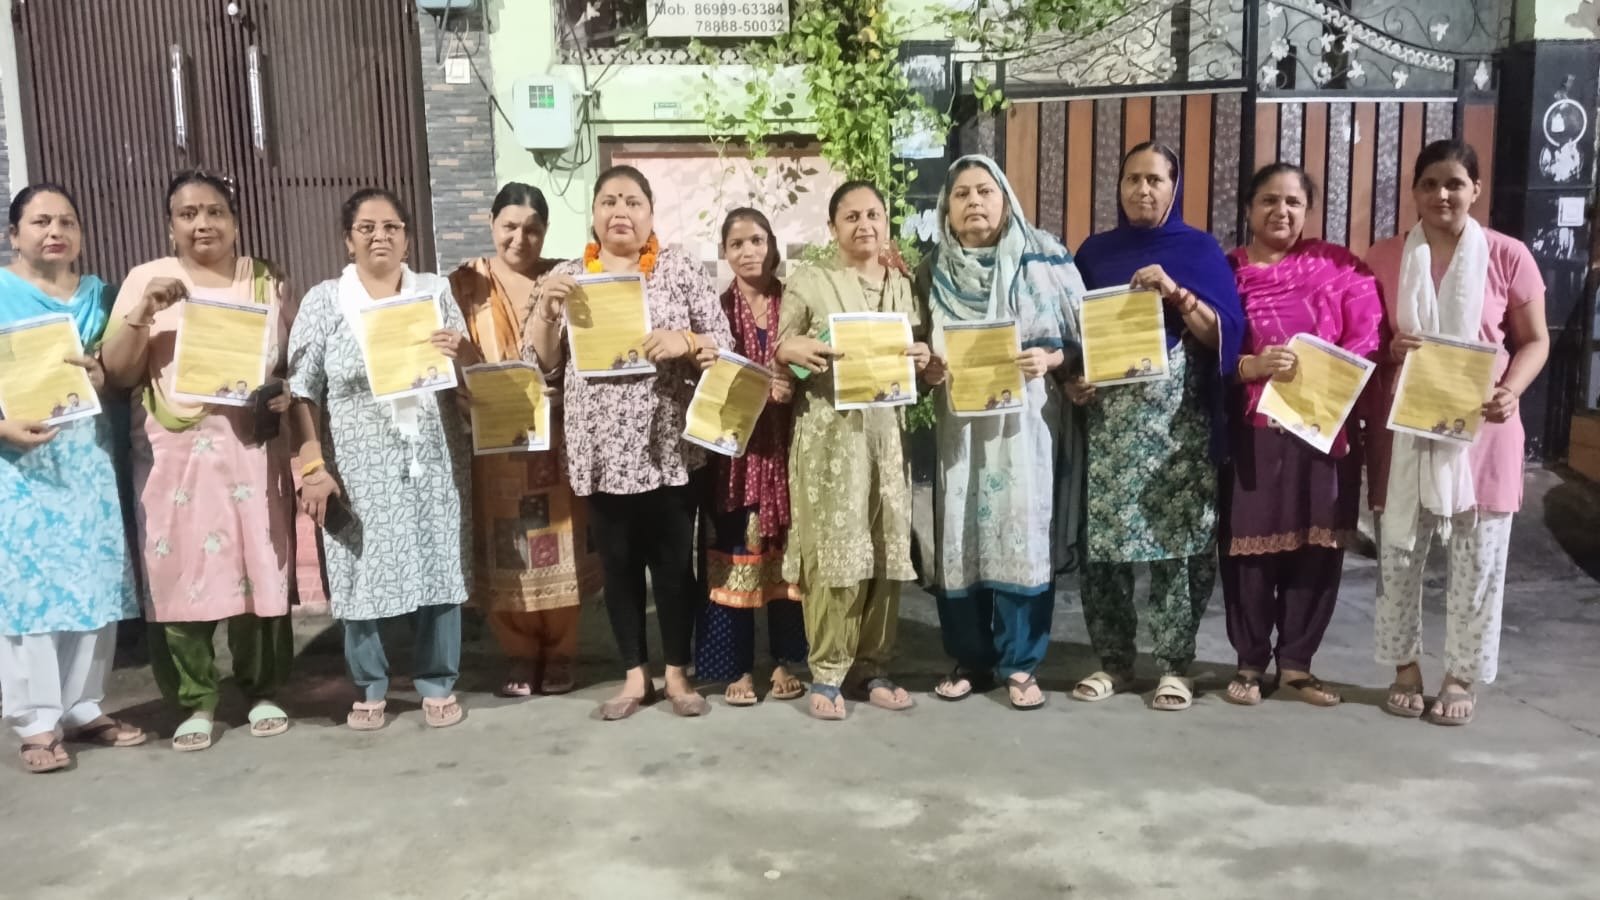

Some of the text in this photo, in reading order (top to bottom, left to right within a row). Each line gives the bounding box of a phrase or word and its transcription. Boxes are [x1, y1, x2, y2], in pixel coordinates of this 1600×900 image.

[654, 3, 784, 15] Mob. 86999-63384
[696, 20, 785, 32] 78888-50032
